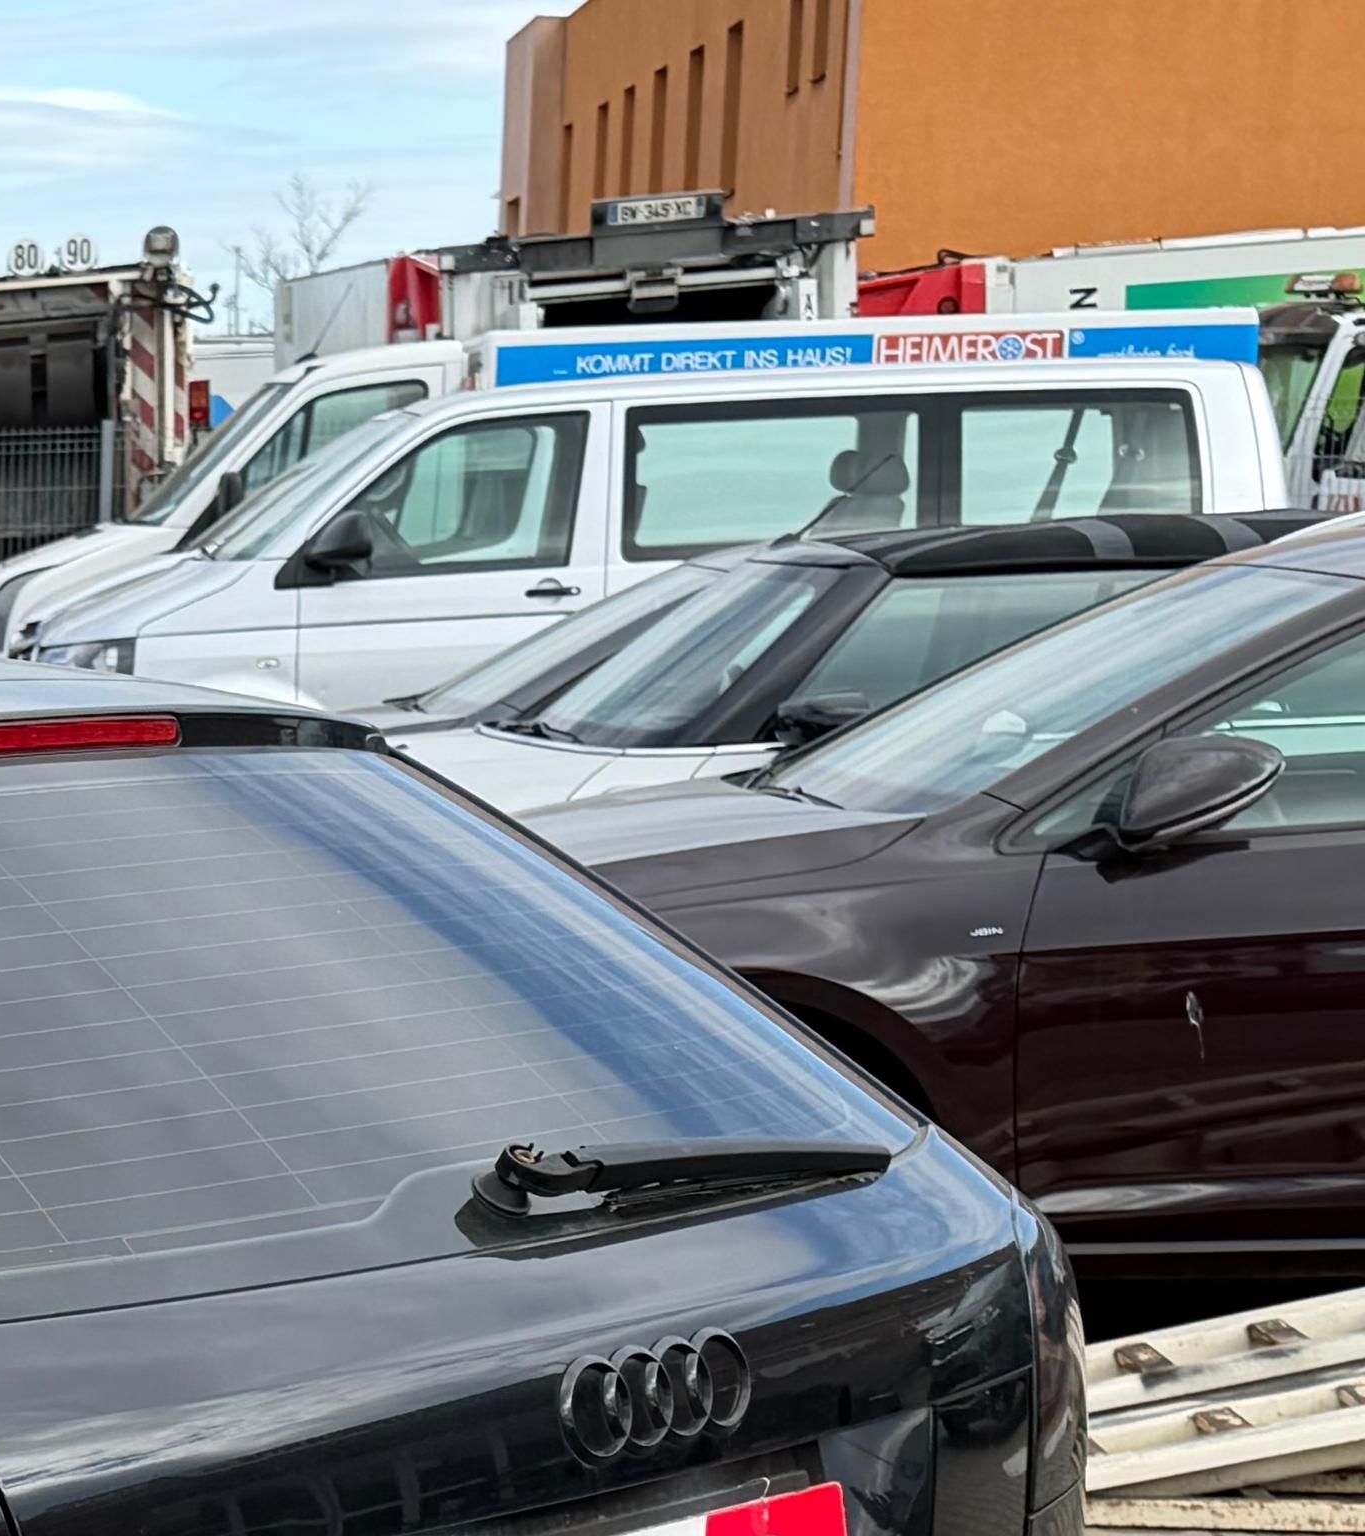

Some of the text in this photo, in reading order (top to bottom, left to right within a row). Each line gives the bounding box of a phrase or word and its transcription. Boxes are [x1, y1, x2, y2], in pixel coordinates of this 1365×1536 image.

[14, 243, 38, 270] 80
[66, 238, 91, 265] 90
[576, 353, 654, 374] KOMMT
[661, 350, 736, 372] DIREKT
[744, 348, 778, 369] INS
[786, 346, 852, 367] HAUS!
